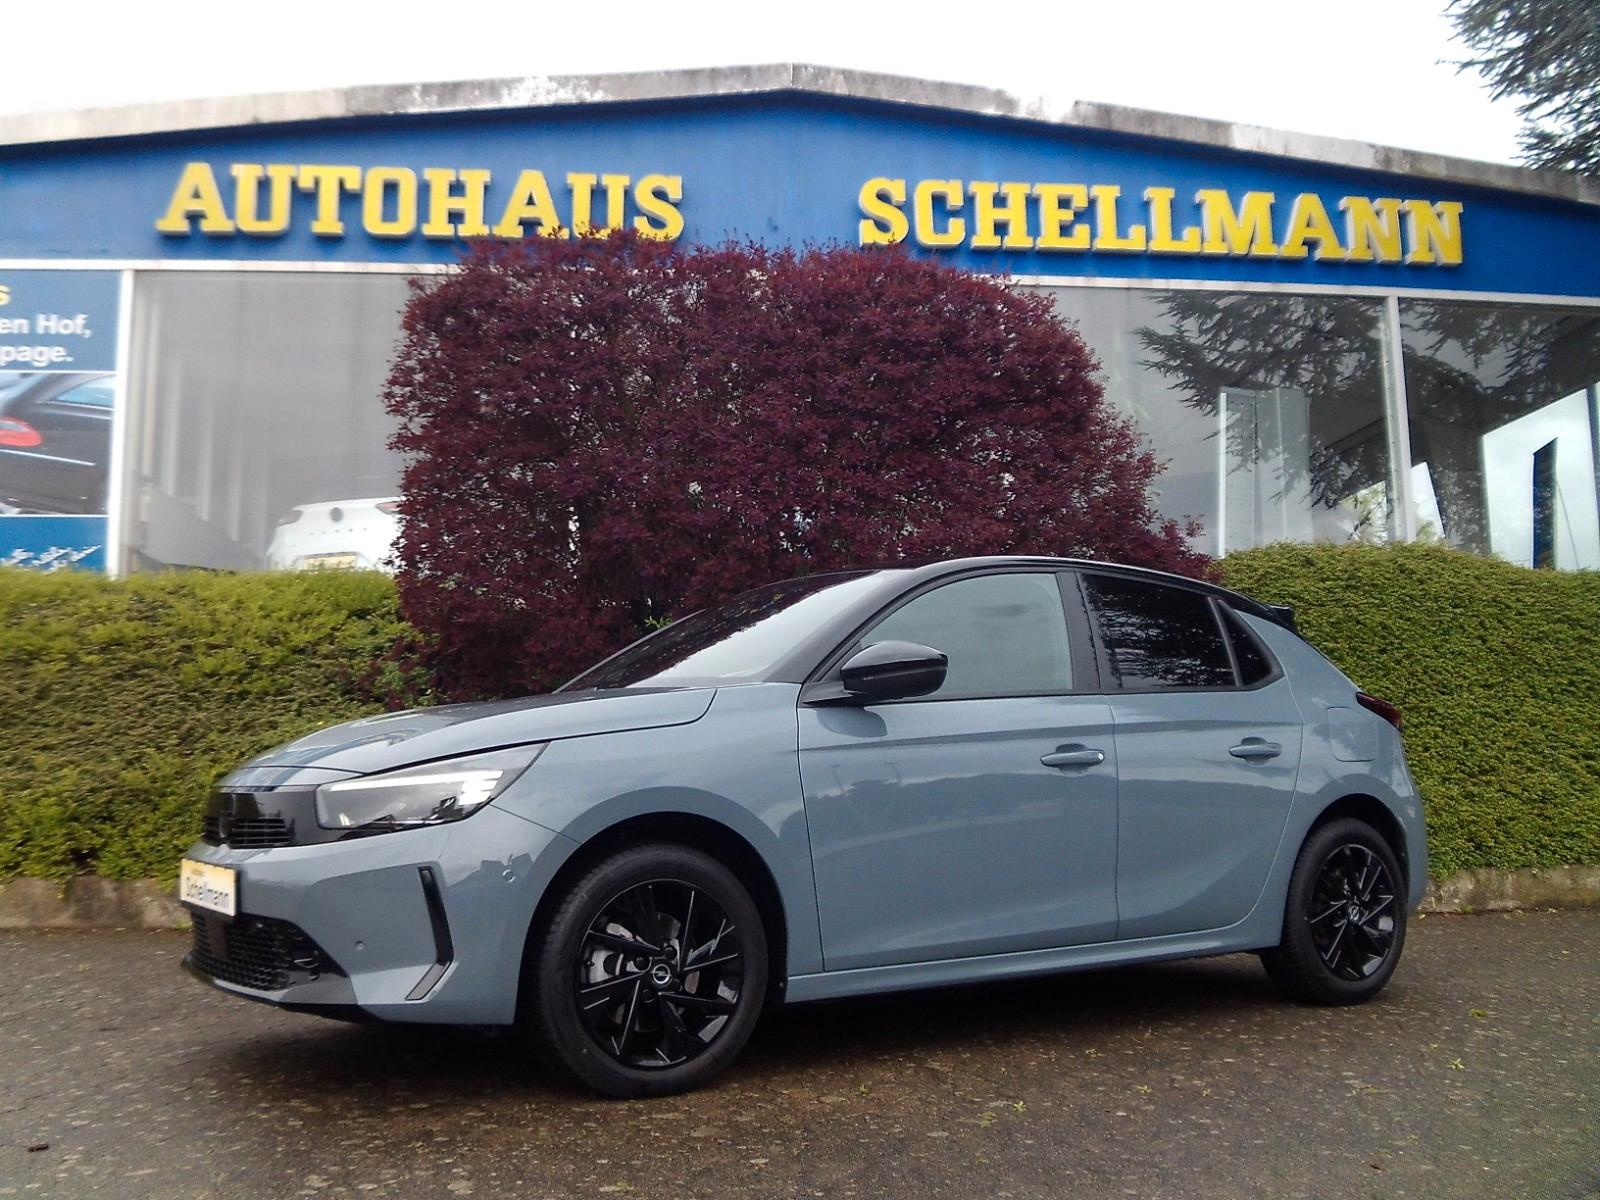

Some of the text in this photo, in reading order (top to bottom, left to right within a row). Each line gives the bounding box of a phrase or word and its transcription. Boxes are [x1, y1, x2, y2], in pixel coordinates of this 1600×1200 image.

[156, 161, 1465, 267] AUTOHAUS SCHELLMANN
[36, 313, 92, 338] Hof,
[0, 346, 75, 367] page.
